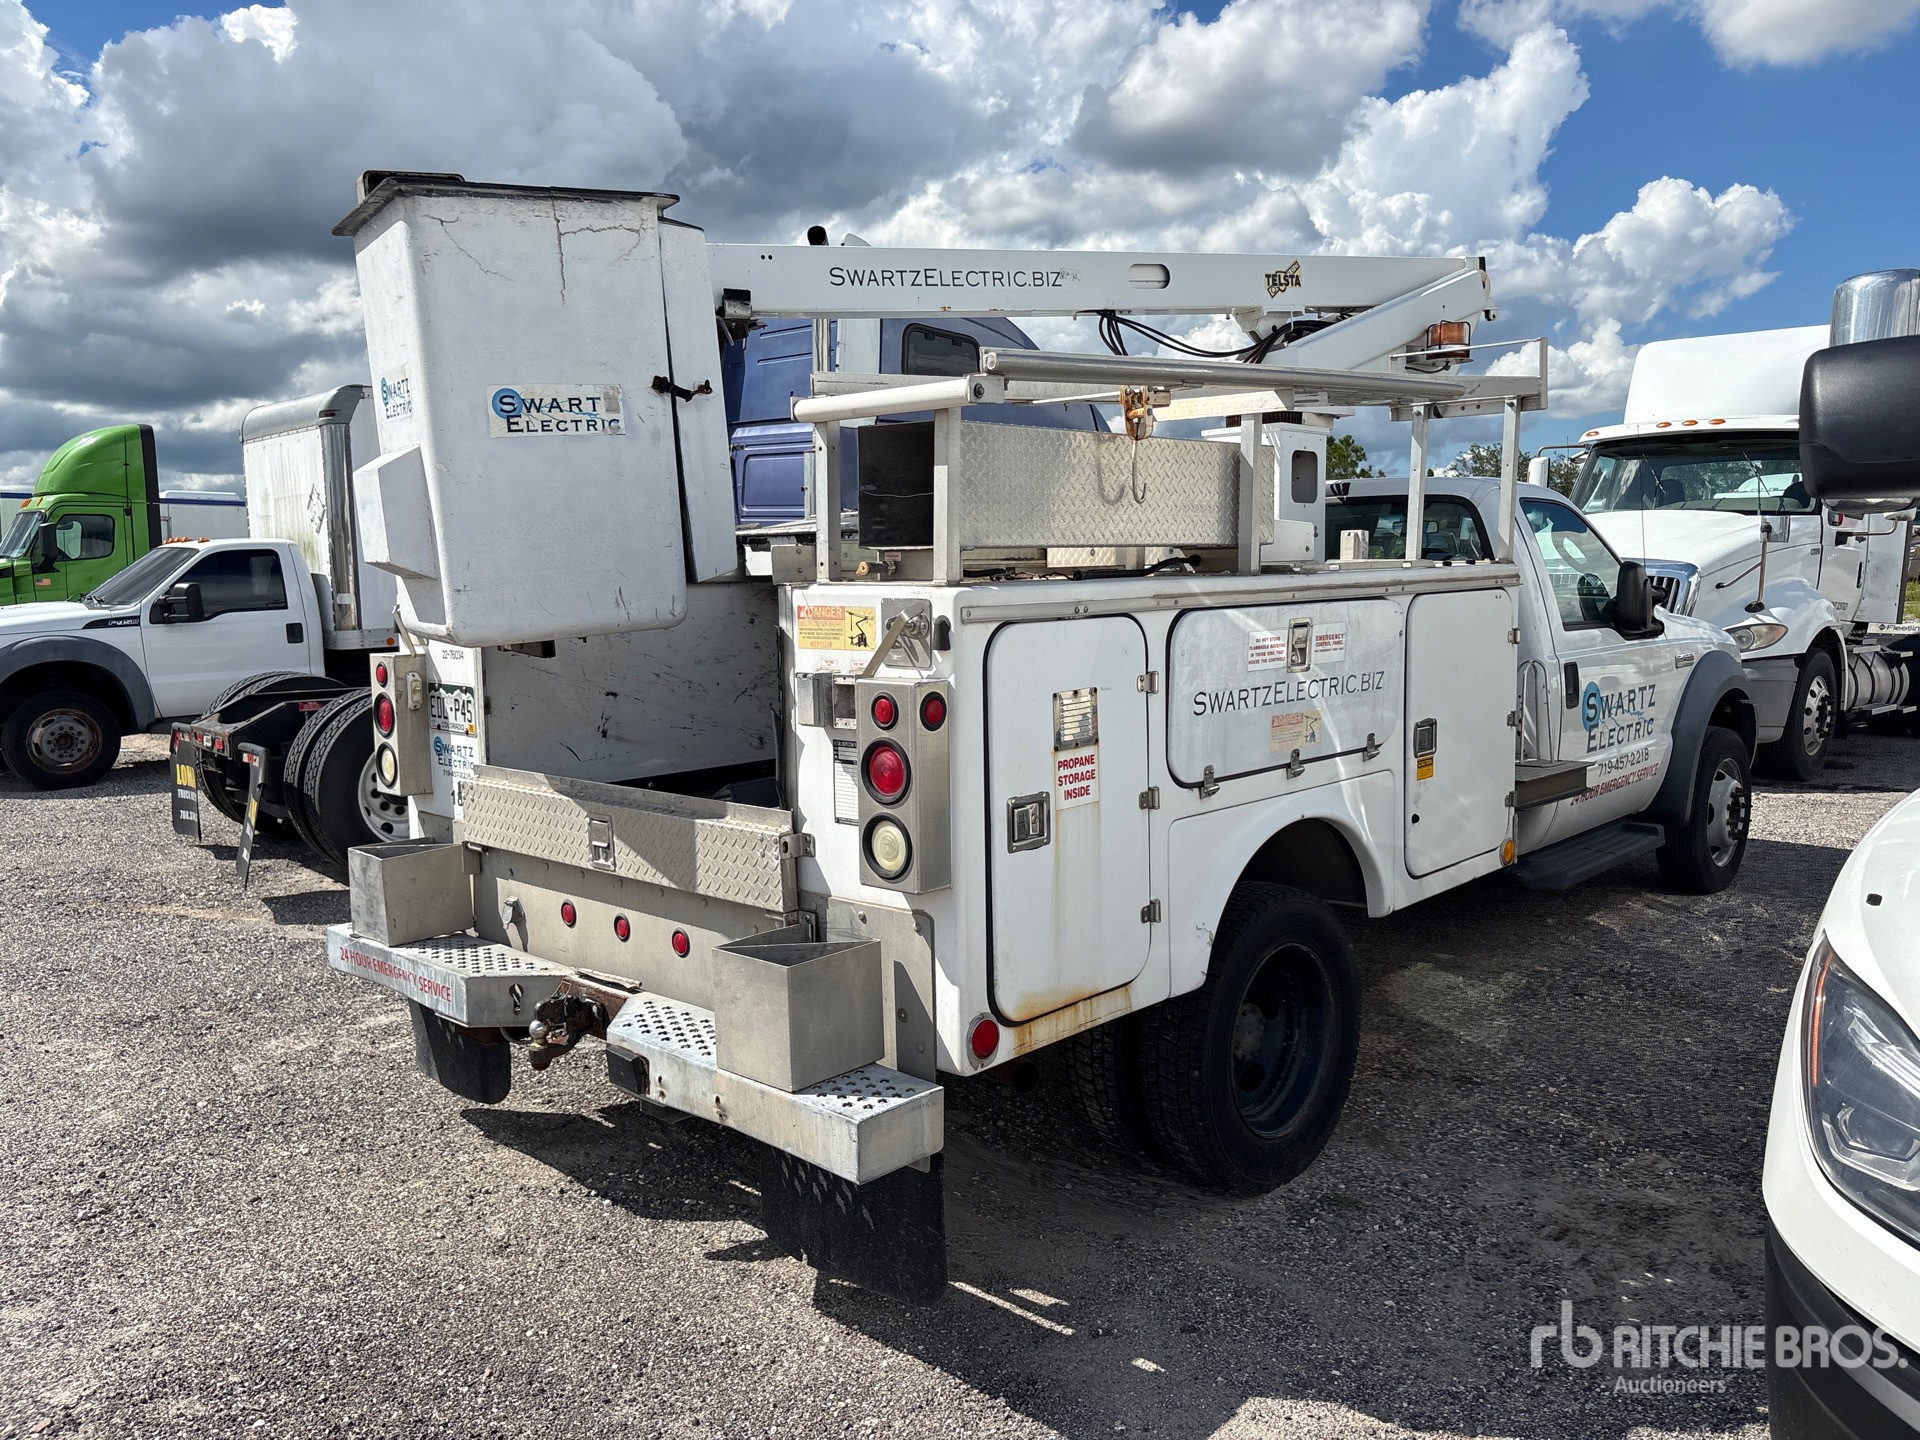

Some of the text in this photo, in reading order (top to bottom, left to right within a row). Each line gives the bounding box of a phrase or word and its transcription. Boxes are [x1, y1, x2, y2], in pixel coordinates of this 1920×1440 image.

[829, 267, 1062, 287] SWARTZELECTRIC.BIZ
[1265, 274, 1301, 287] TELSTA
[382, 378, 410, 402] SWARTZ
[386, 401, 412, 419] ELECTRIC
[499, 394, 602, 414] SWART
[807, 606, 842, 618] DANGER
[1315, 634, 1344, 642] EMERGENCY
[1193, 671, 1385, 717] SWARTZELECTRIC.BIZ
[1586, 684, 1656, 723] SWARTZ
[441, 721, 465, 731] COLORADO
[1587, 718, 1654, 753] ELECTRIC
[436, 740, 474, 757] SWARTZ
[437, 753, 474, 770] ELECTRIC
[1057, 754, 1096, 772] PROPANE
[1598, 747, 1650, 777] 719-457-2218
[1057, 769, 1097, 787] STORAGE
[1600, 771, 1637, 794] EMERGENCY
[1635, 763, 1659, 782] SERVICE
[1064, 785, 1091, 801] INSIDE
[340, 946, 452, 1002] 24 HOUR EMERGENCY SERVICE
